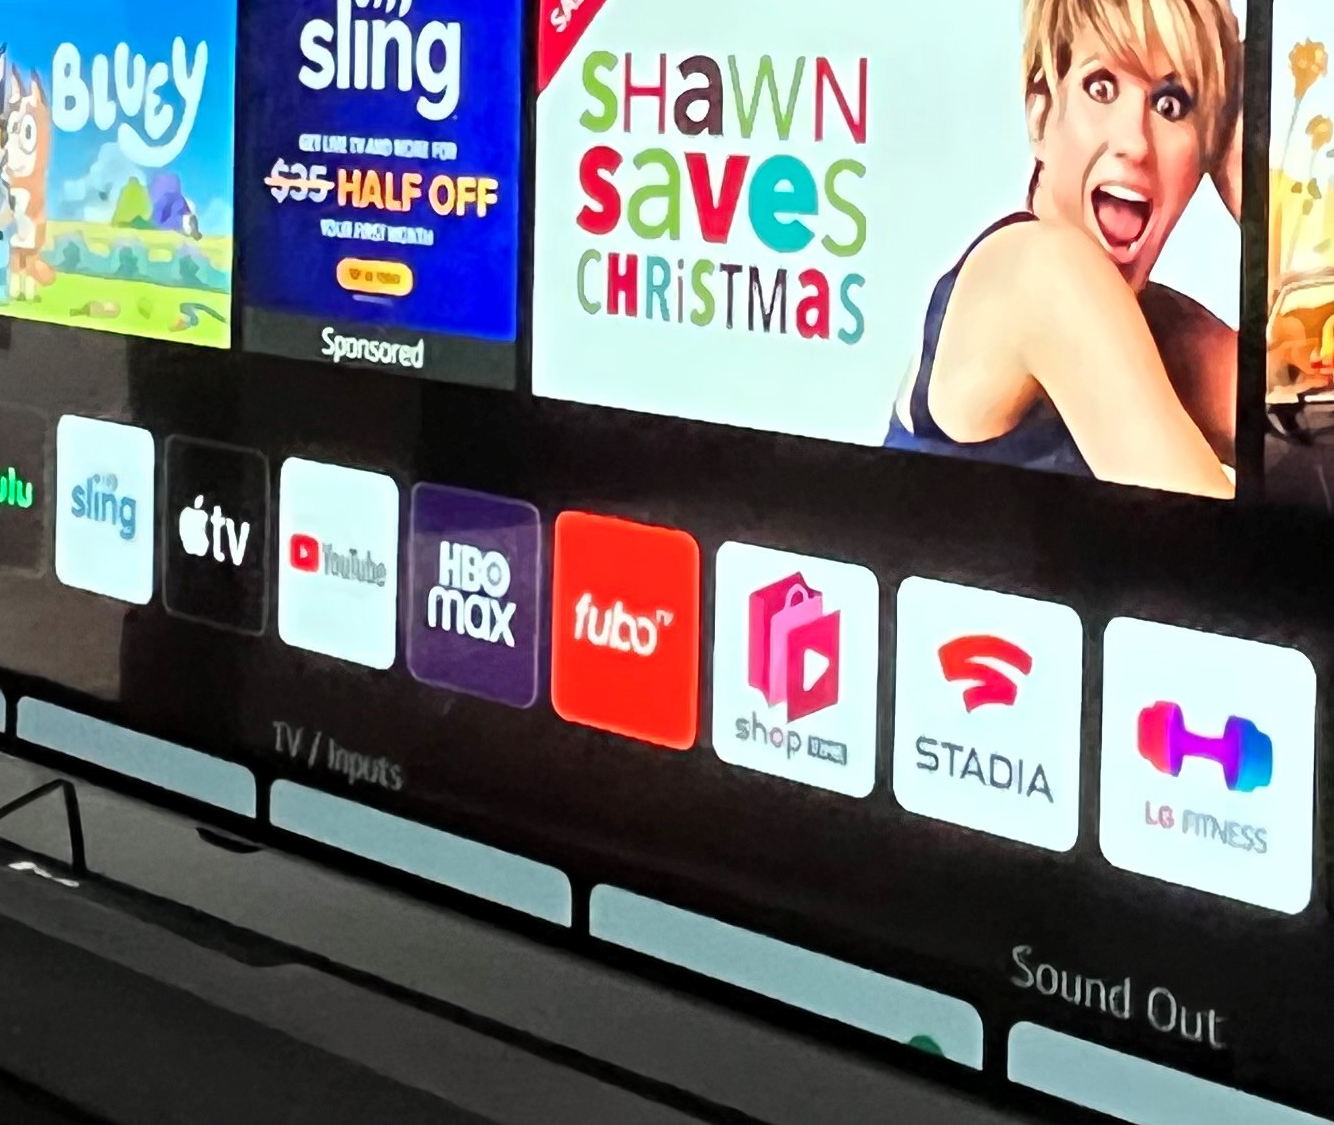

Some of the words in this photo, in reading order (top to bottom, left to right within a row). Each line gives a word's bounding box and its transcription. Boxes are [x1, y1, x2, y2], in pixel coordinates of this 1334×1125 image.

[268, 157, 329, 203] $35
[337, 168, 423, 212] HALF
[428, 174, 499, 217] OFF
[321, 327, 424, 369] Sponsored
[71, 473, 136, 540] sling
[211, 505, 250, 566] tv
[322, 543, 387, 587] YouTube
[438, 540, 511, 599] HBO
[427, 585, 517, 647] max
[272, 720, 304, 758] TV
[308, 730, 322, 770] /
[328, 737, 403, 791] Inputs
[735, 710, 802, 760] shop
[915, 735, 1055, 804] STADIA
[1145, 800, 1175, 829] LG
[1182, 809, 1268, 854] FITNESS
[1011, 945, 1130, 1019] Sound
[1147, 987, 1227, 1049] Out
